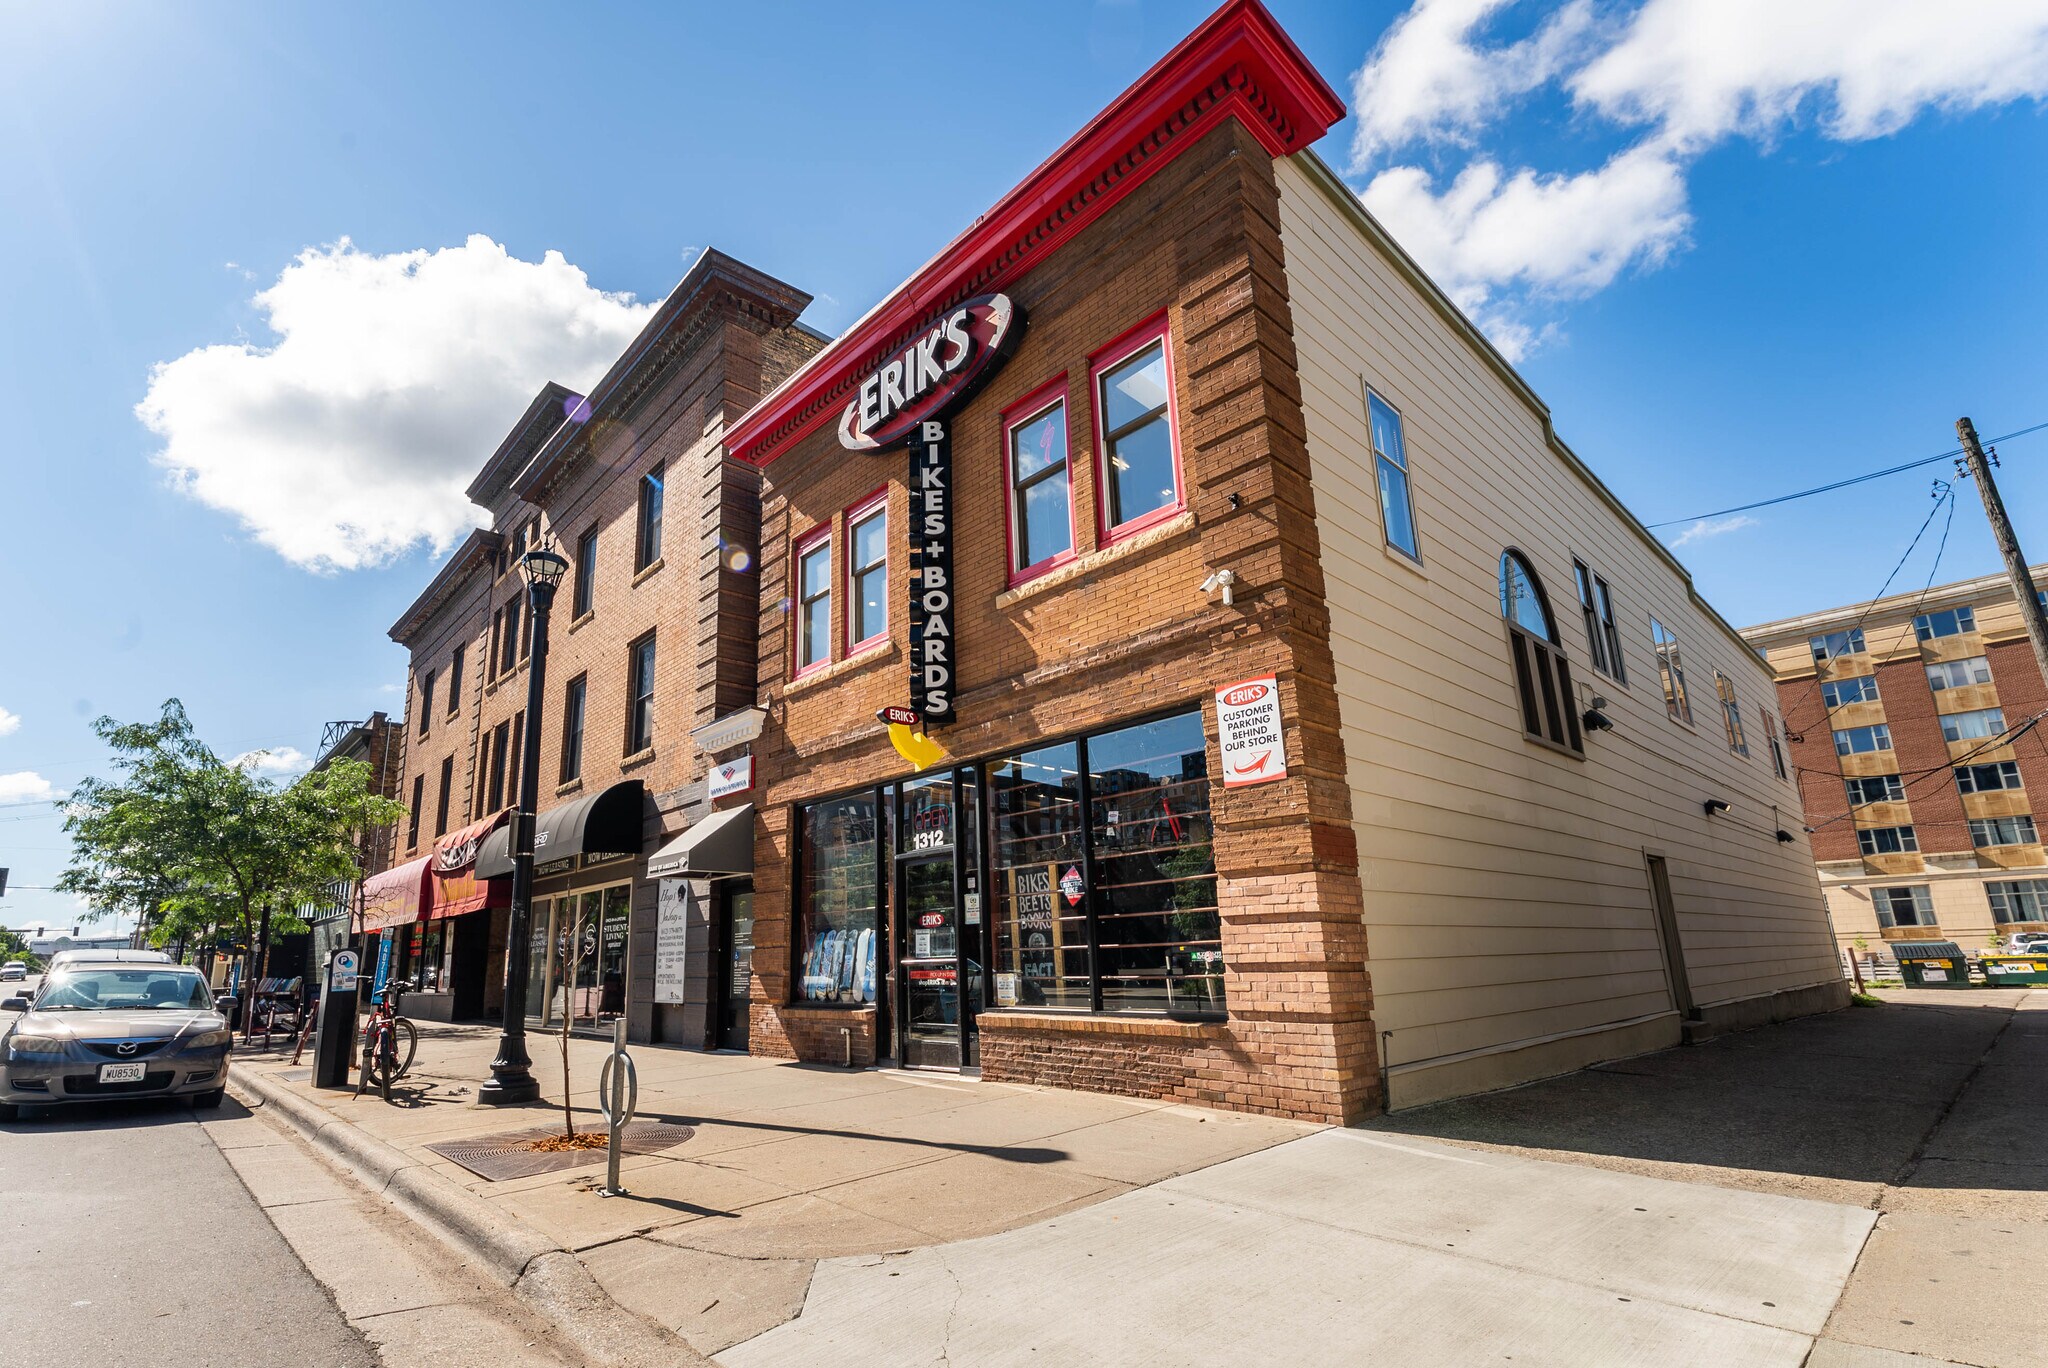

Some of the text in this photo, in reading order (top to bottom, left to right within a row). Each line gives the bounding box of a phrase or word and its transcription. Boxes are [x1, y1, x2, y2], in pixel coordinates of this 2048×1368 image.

[859, 308, 970, 434] ERIK'S
[921, 421, 946, 535] BIKES
[922, 566, 950, 713] BOARDS
[1229, 685, 1263, 705] ERIK'S
[1223, 703, 1274, 723] CUSTOMER
[1227, 714, 1271, 732] PARKING
[1225, 733, 1278, 752] OUR STORE
[1232, 725, 1268, 741] BEHIND
[915, 807, 949, 830] OPEN
[913, 829, 944, 850] 1312
[1017, 871, 1050, 894] BIKES
[1019, 894, 1052, 914] BEETS
[603, 923, 628, 934] STUDENT
[1020, 911, 1053, 930] BOOKS
[605, 931, 624, 941] LIVING
[1024, 962, 1054, 977] FACT
[106, 1068, 140, 1079] WU8530
